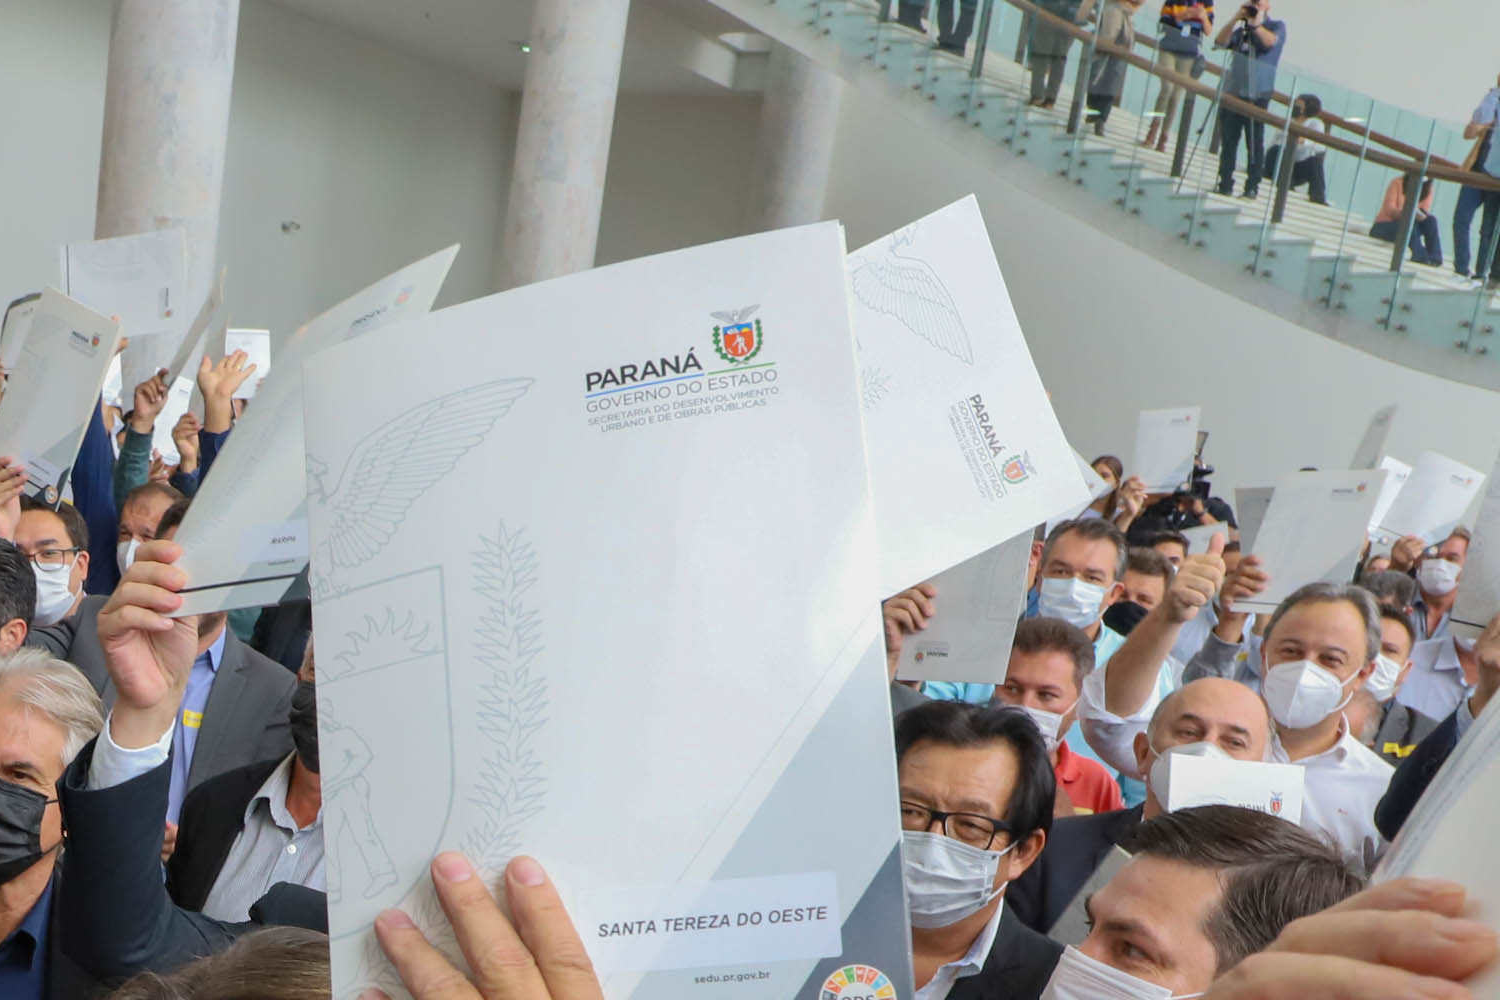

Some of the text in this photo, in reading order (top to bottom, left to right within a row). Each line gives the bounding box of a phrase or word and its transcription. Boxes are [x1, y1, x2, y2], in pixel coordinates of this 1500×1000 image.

[585, 347, 703, 392] PARANÁ
[586, 368, 778, 413] GOVERNO DO ESTADO
[587, 387, 779, 426] SECRETARIA DO DESENVOLVIMENTO
[601, 398, 767, 433] URBANO E DE OBRAS PÚBLICAS
[970, 393, 1006, 458] PARANÁ
[597, 906, 828, 938] SANTA TEREZA DO OESTE
[694, 970, 771, 984] sedu.pr.gov.br
